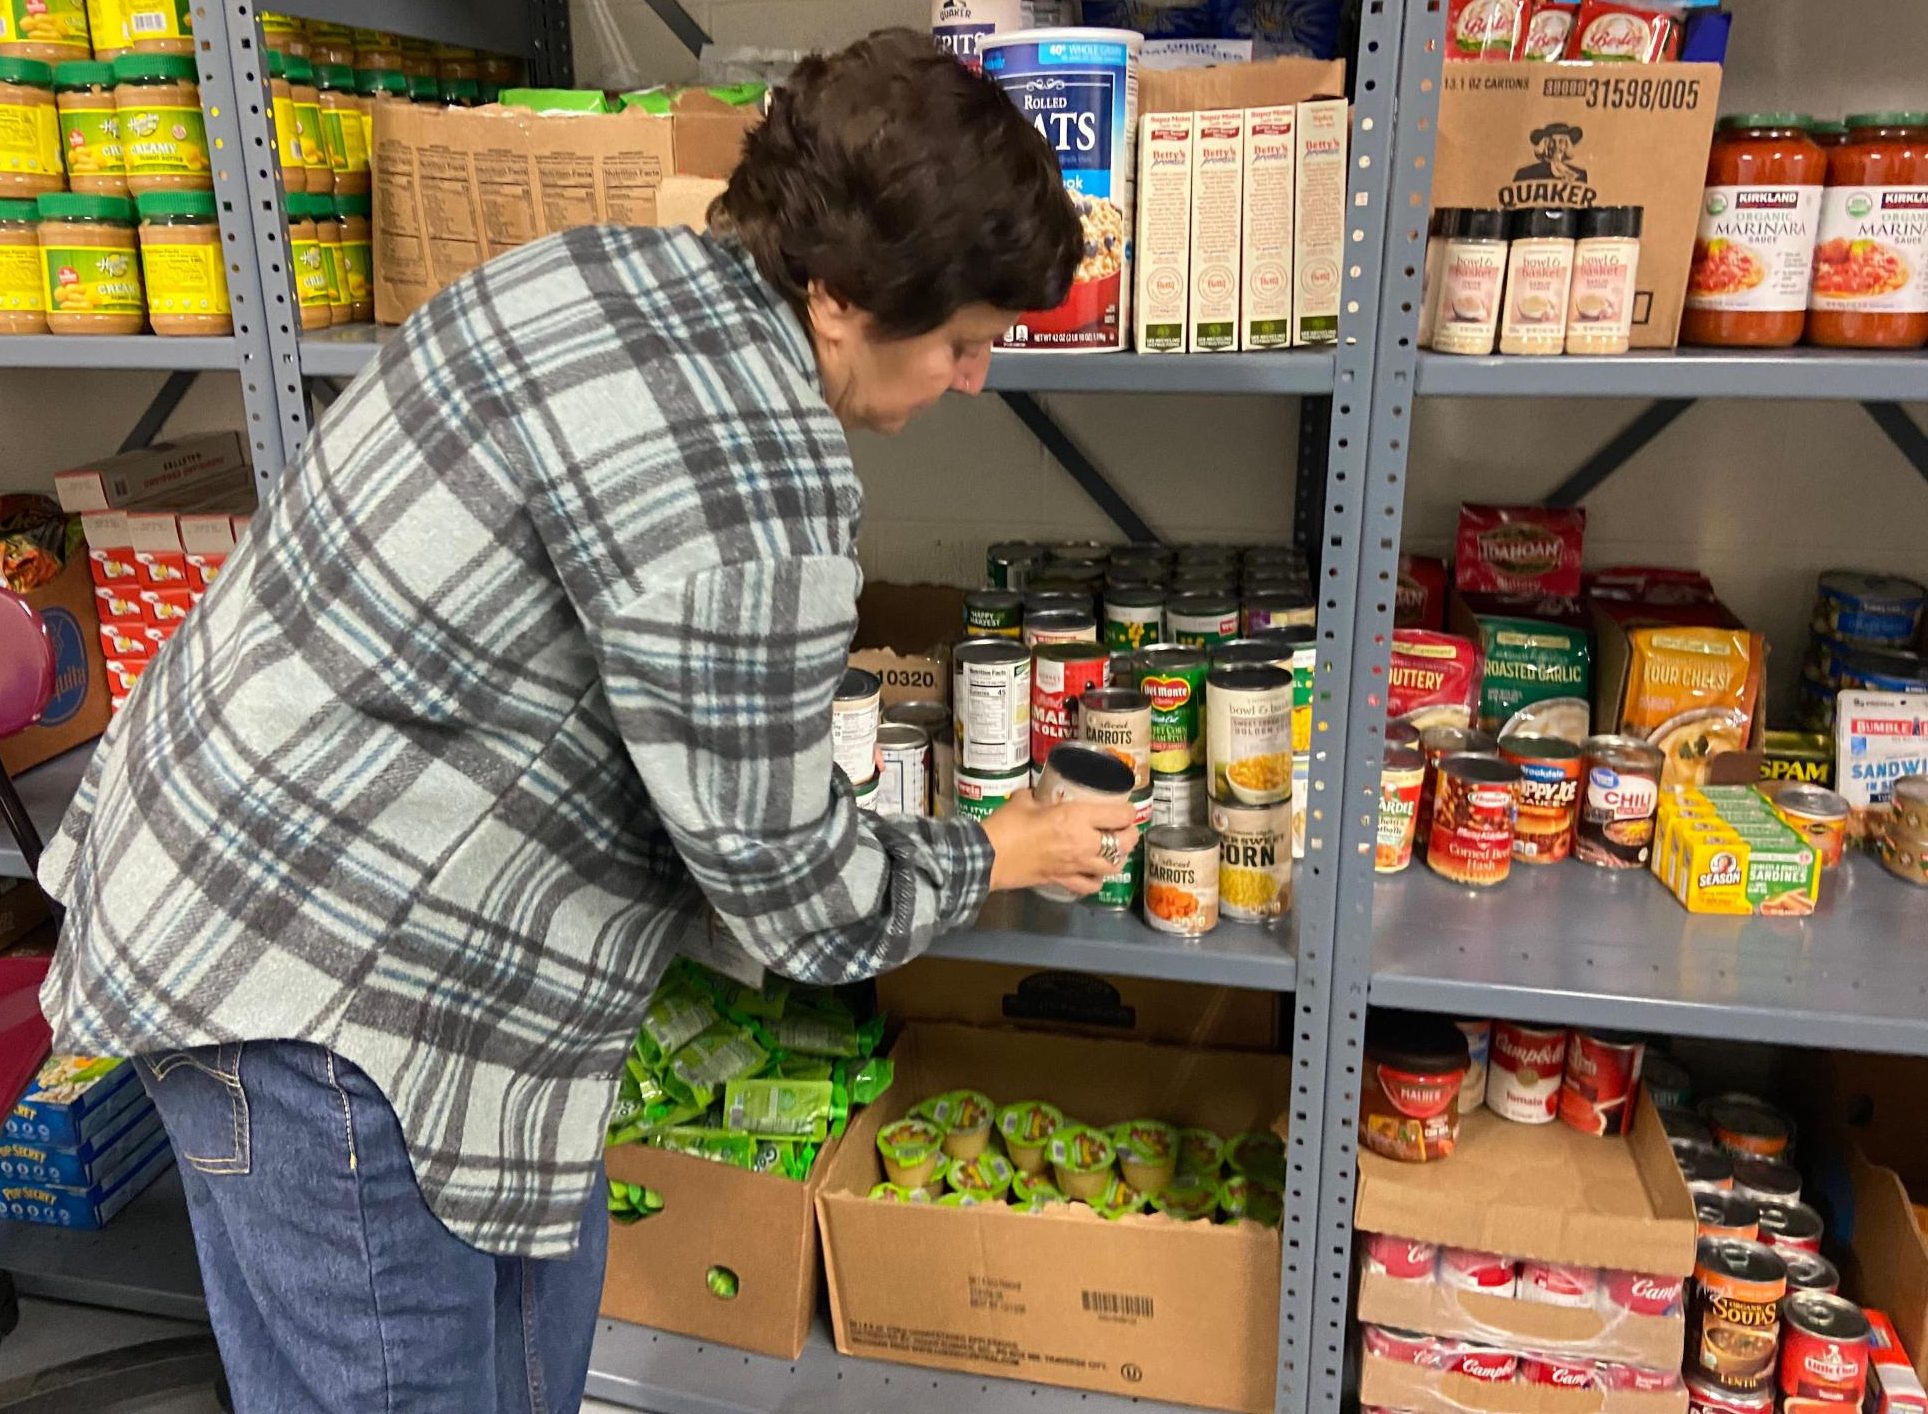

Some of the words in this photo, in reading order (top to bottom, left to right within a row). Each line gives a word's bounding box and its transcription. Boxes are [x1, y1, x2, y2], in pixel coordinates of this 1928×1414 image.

[940, 9, 971, 21] QUAKER
[1069, 45, 1099, 56] WHOLE
[1484, 77, 1529, 90] CARTONS
[1586, 79, 1700, 110] 31598/005
[1024, 95, 1067, 110] ROLLED
[1034, 111, 1096, 151] ATS
[1254, 143, 1288, 155] Betty's
[1305, 138, 1340, 151] Betty's
[1153, 148, 1185, 160] Betty's
[1203, 145, 1236, 158] Betty's
[1497, 184, 1598, 207] QUAKER
[1739, 193, 1797, 203] KIRKLAND
[1735, 211, 1793, 222] ORGANIC
[1715, 220, 1806, 237] MARINARA
[1749, 235, 1778, 245] SAUCE
[1895, 236, 1922, 245] SAUCE
[1456, 255, 1484, 267] bowl
[1523, 255, 1550, 268] bowl
[1582, 254, 1610, 266] bowl
[971, 610, 994, 619] HAPPY
[970, 617, 1001, 627] HARVEST
[969, 668, 991, 676] Nutrition
[1484, 660, 1536, 680] ROASTED
[1538, 665, 1581, 682] GARLIC
[1144, 686, 1156, 696] Del
[1158, 686, 1187, 698] Monte
[1229, 704, 1255, 716] bowl
[1100, 720, 1128, 729] sliced
[1857, 721, 1911, 734] BUMBLE
[1086, 727, 1132, 744] CARROTS
[1759, 761, 1829, 782] SPAM
[959, 782, 981, 798] weis
[1604, 791, 1652, 808] CHILI
[1220, 844, 1275, 868] CORN
[1449, 843, 1489, 860] Corned
[1161, 860, 1191, 869] sliced
[1467, 858, 1496, 871] Hash
[1150, 863, 1195, 884] CARROTS
[1699, 870, 1741, 888] SEASON
[1749, 870, 1808, 883] SARDINES
[1506, 1089, 1543, 1106] Tomato
[1713, 1296, 1776, 1326] SOUPS
[1721, 1374, 1757, 1389] LENTIL
